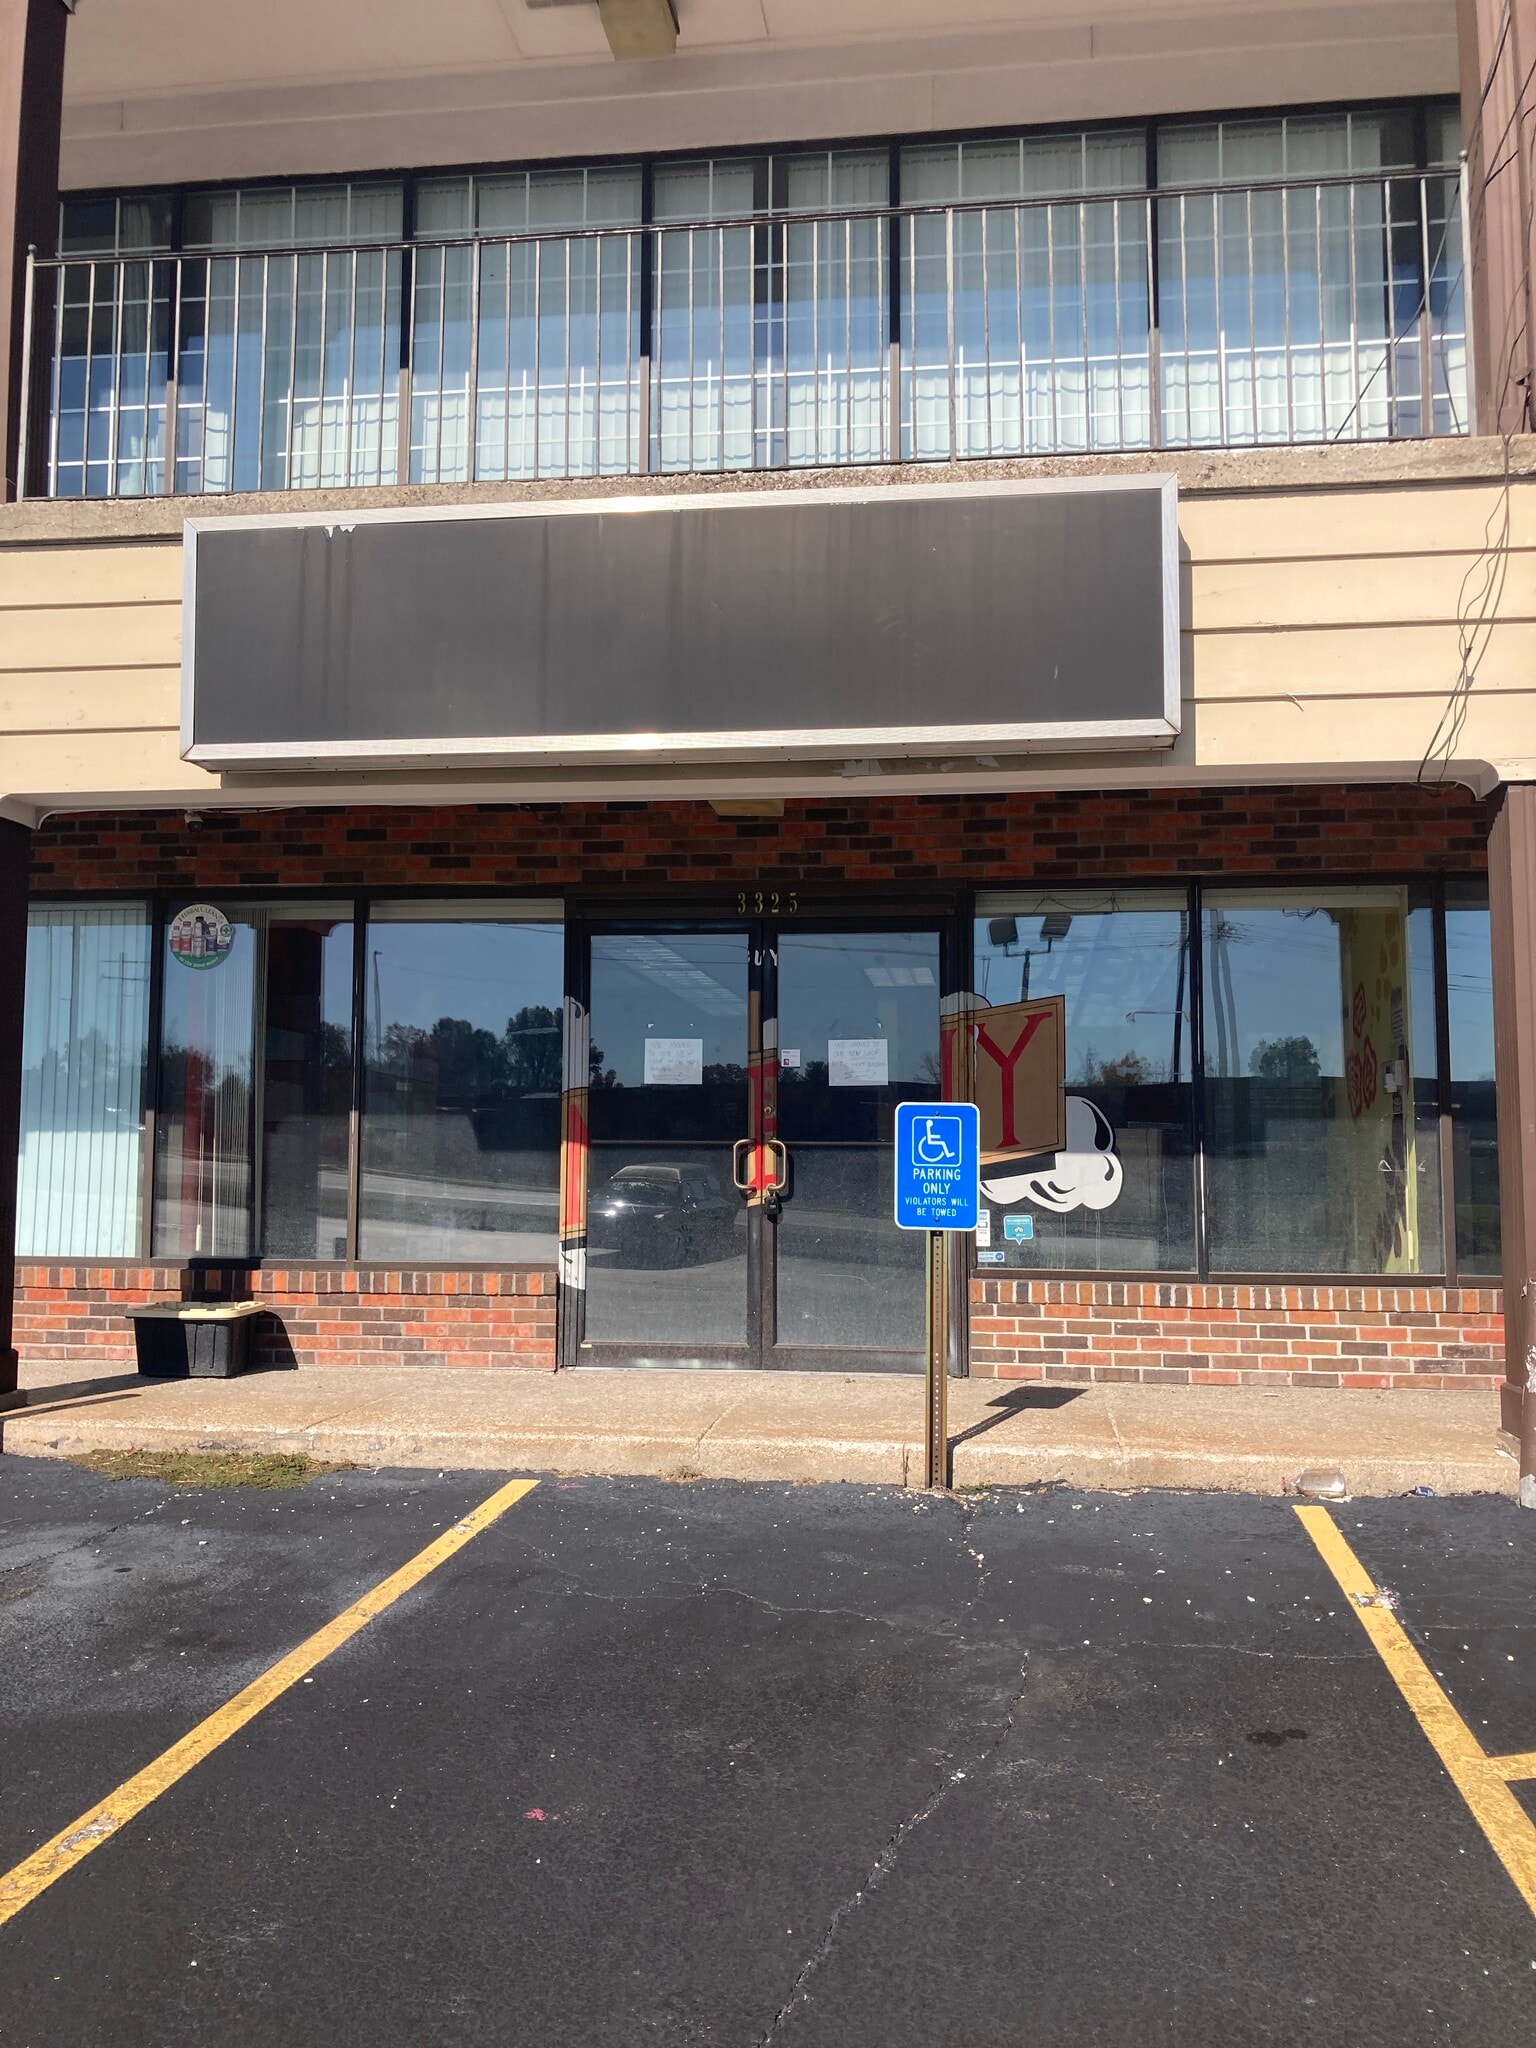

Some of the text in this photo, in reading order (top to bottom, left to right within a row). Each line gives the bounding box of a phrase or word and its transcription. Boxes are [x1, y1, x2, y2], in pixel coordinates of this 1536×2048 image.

[737, 891, 798, 914] 3325
[912, 1167, 961, 1181] PARKING
[922, 1182, 951, 1195] ONLY
[904, 1196, 969, 1207] VIOLATORS WILL
[916, 1207, 957, 1217] BE TOWED
